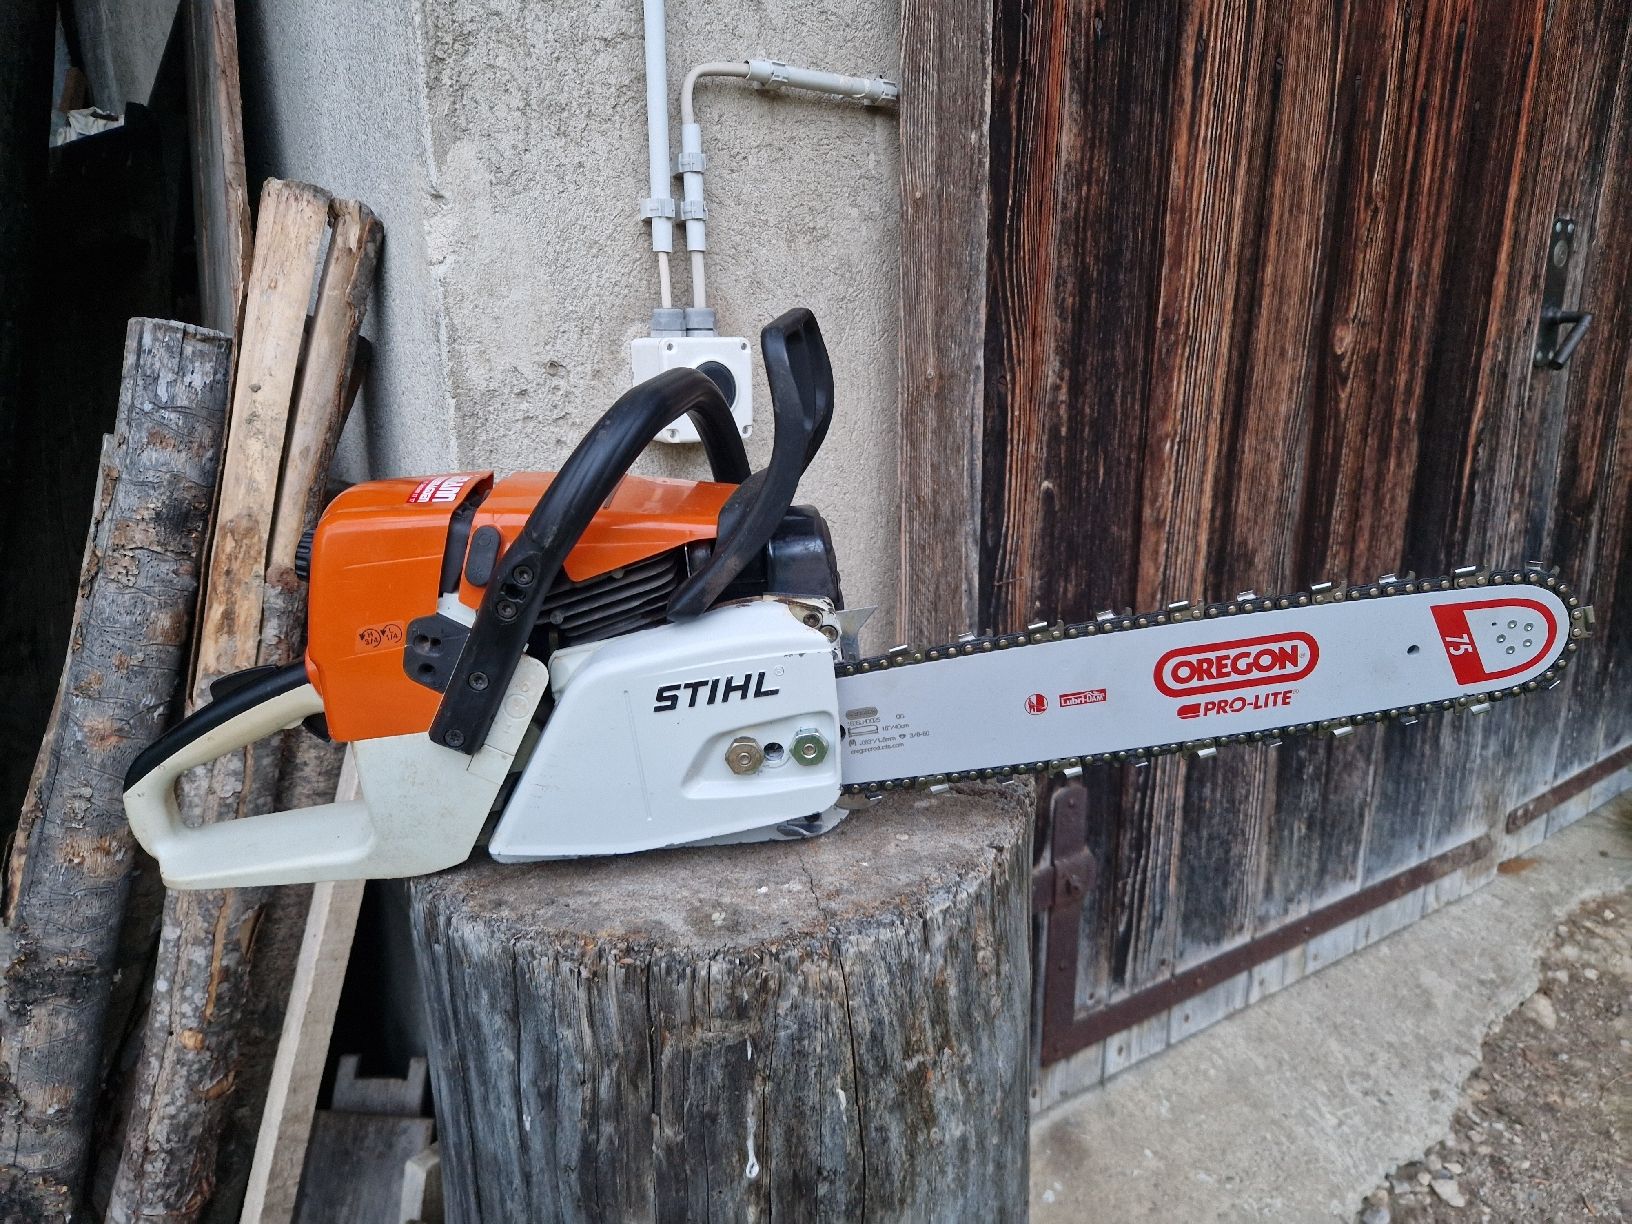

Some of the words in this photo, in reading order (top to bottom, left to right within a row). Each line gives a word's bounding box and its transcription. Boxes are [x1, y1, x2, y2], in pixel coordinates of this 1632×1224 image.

[1170, 644, 1299, 685] OREGON
[653, 671, 780, 713] STIHL
[1203, 689, 1293, 717] PRO-LITE
